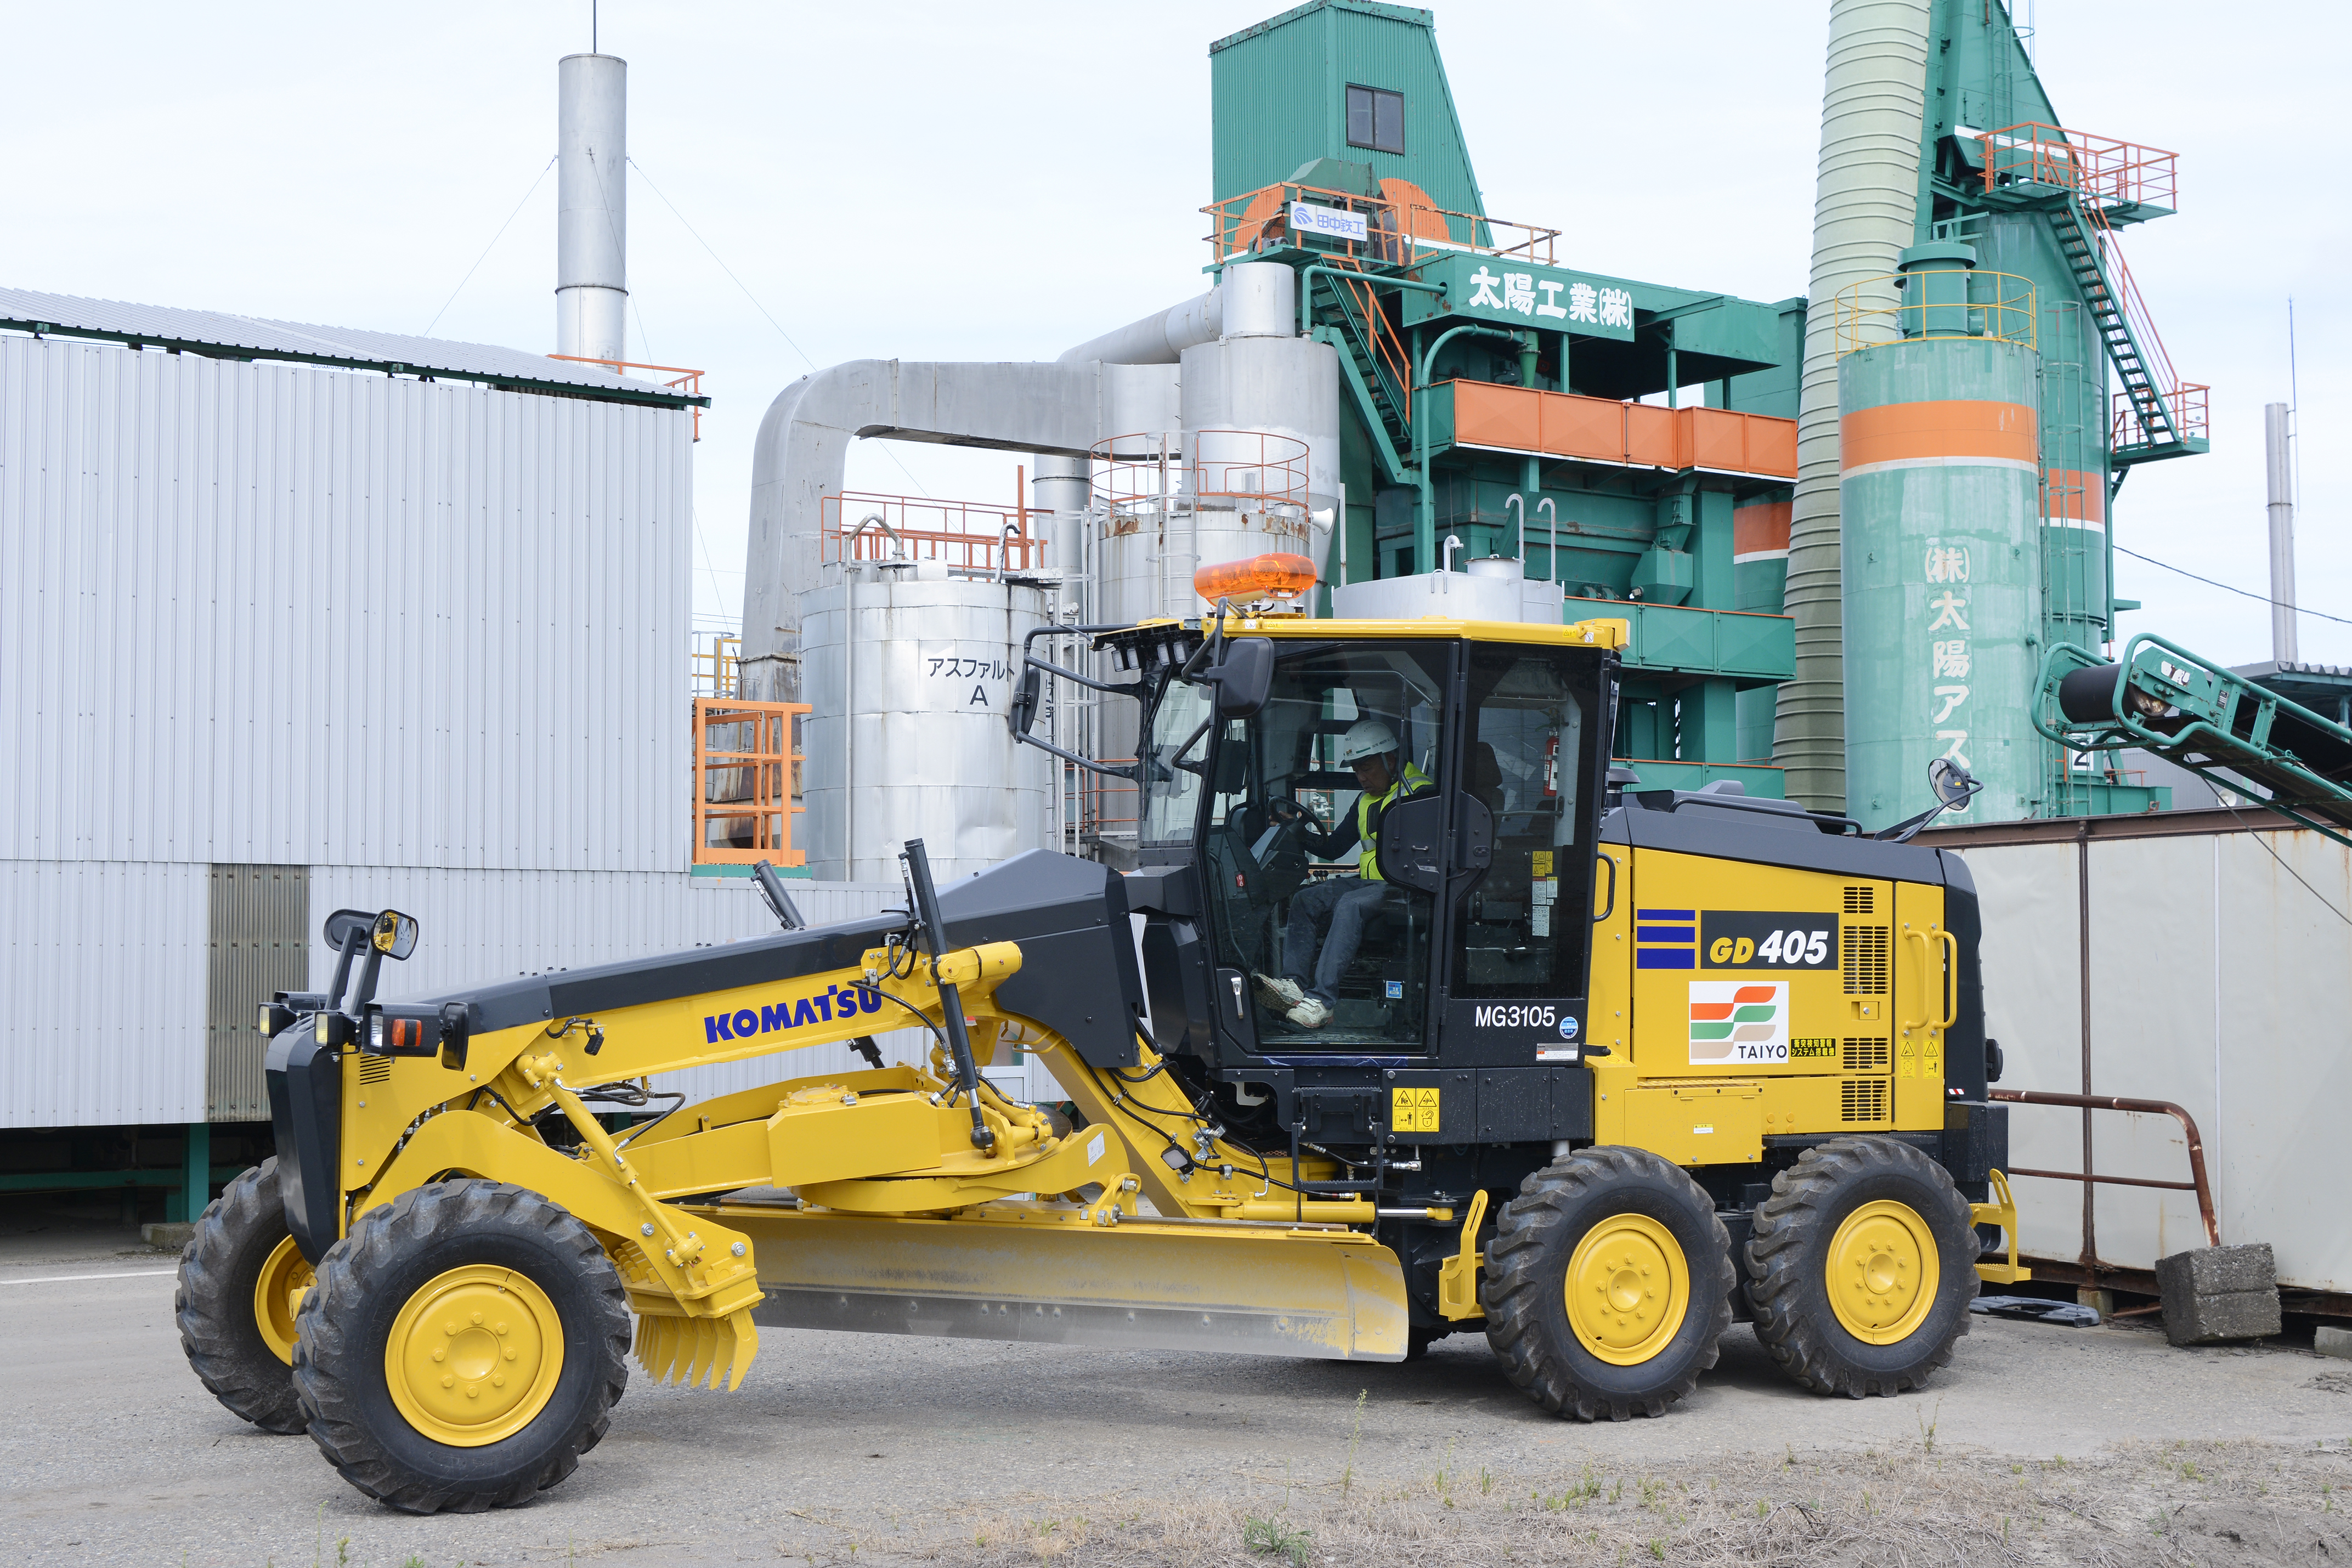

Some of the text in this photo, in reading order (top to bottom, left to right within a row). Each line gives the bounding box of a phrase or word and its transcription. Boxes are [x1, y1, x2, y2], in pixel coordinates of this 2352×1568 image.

[1318, 214, 1364, 235] 田中鉄工
[928, 658, 1015, 681] アスファルト
[1925, 547, 1971, 814] (株)太陽アス
[970, 685, 988, 706] A
[1710, 930, 1829, 965] GD 405
[704, 984, 881, 1043] KOMATSU
[1475, 1006, 1555, 1027] MG3105
[1738, 1045, 1787, 1058] TAIYO
[1791, 1047, 1834, 1056] システム搭載機
[1794, 1039, 1832, 1048] 衝突検知警報
[363, 1244, 466, 1361] YOKOHAMA
